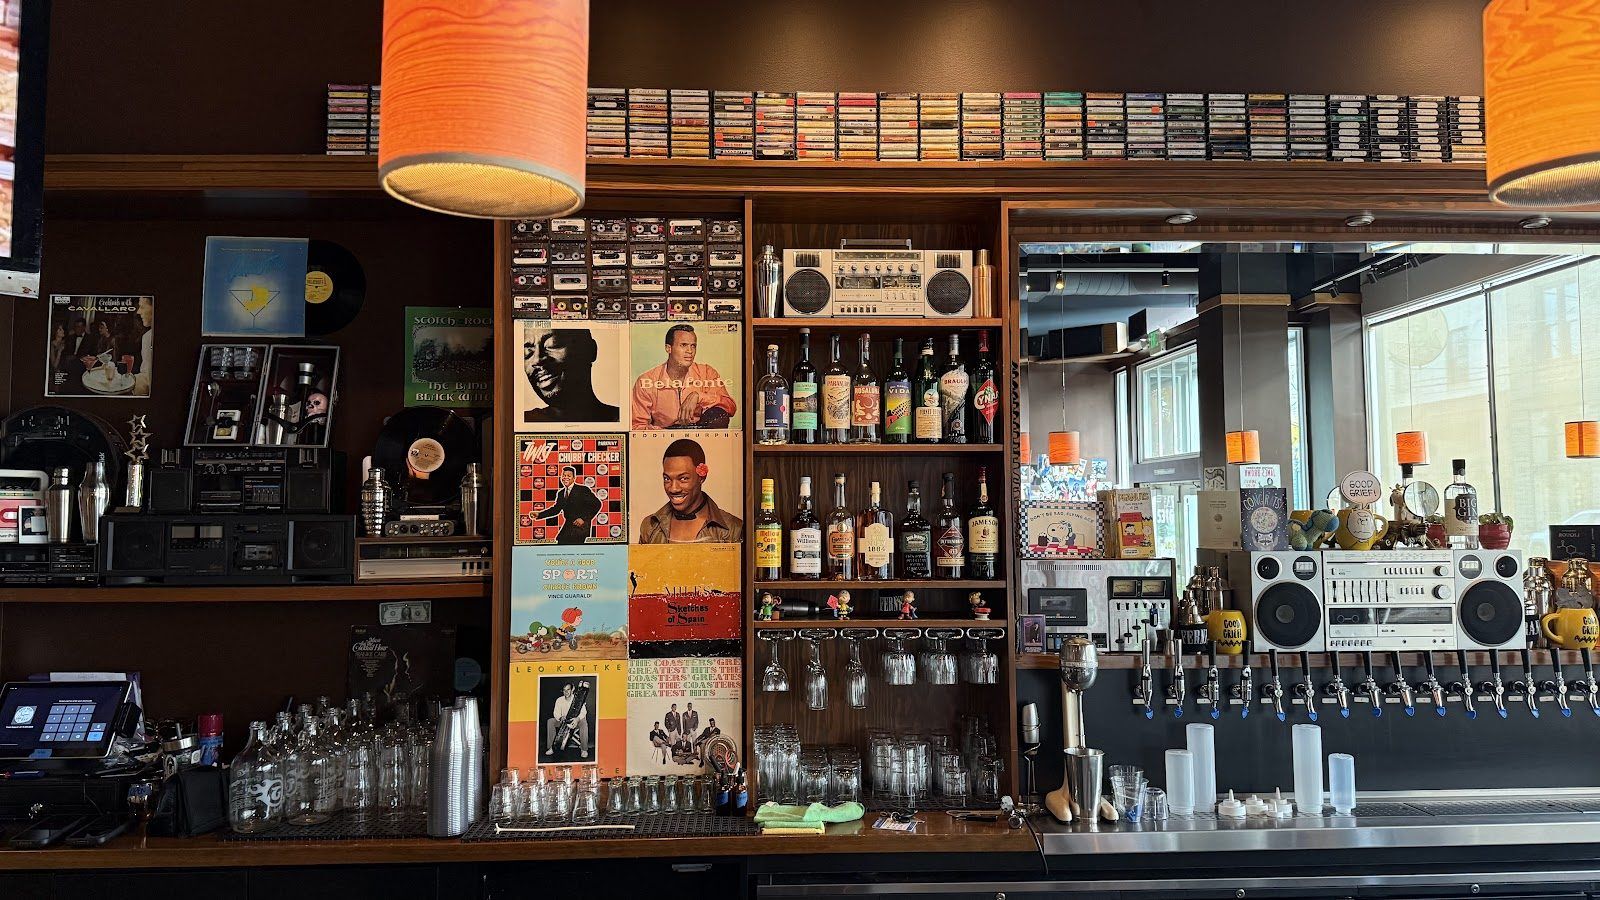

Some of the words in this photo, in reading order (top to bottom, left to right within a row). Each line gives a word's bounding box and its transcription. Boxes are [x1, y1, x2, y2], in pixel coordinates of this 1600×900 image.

[464, 317, 492, 325] ROC
[640, 378, 734, 390] Belafonte
[415, 392, 454, 402] BLACK
[558, 453, 586, 463] CHUBBY
[587, 453, 620, 462] CHECKER
[1349, 480, 1374, 488] GOOD
[1349, 488, 1377, 497] GRIEF!
[1459, 498, 1477, 508] BIG
[1457, 508, 1477, 517] GIN
[667, 602, 709, 614] Sketches
[667, 615, 675, 623] of
[676, 613, 705, 624] Spain
[556, 664, 621, 672] KOTTKE
[627, 682, 653, 690] HITS
